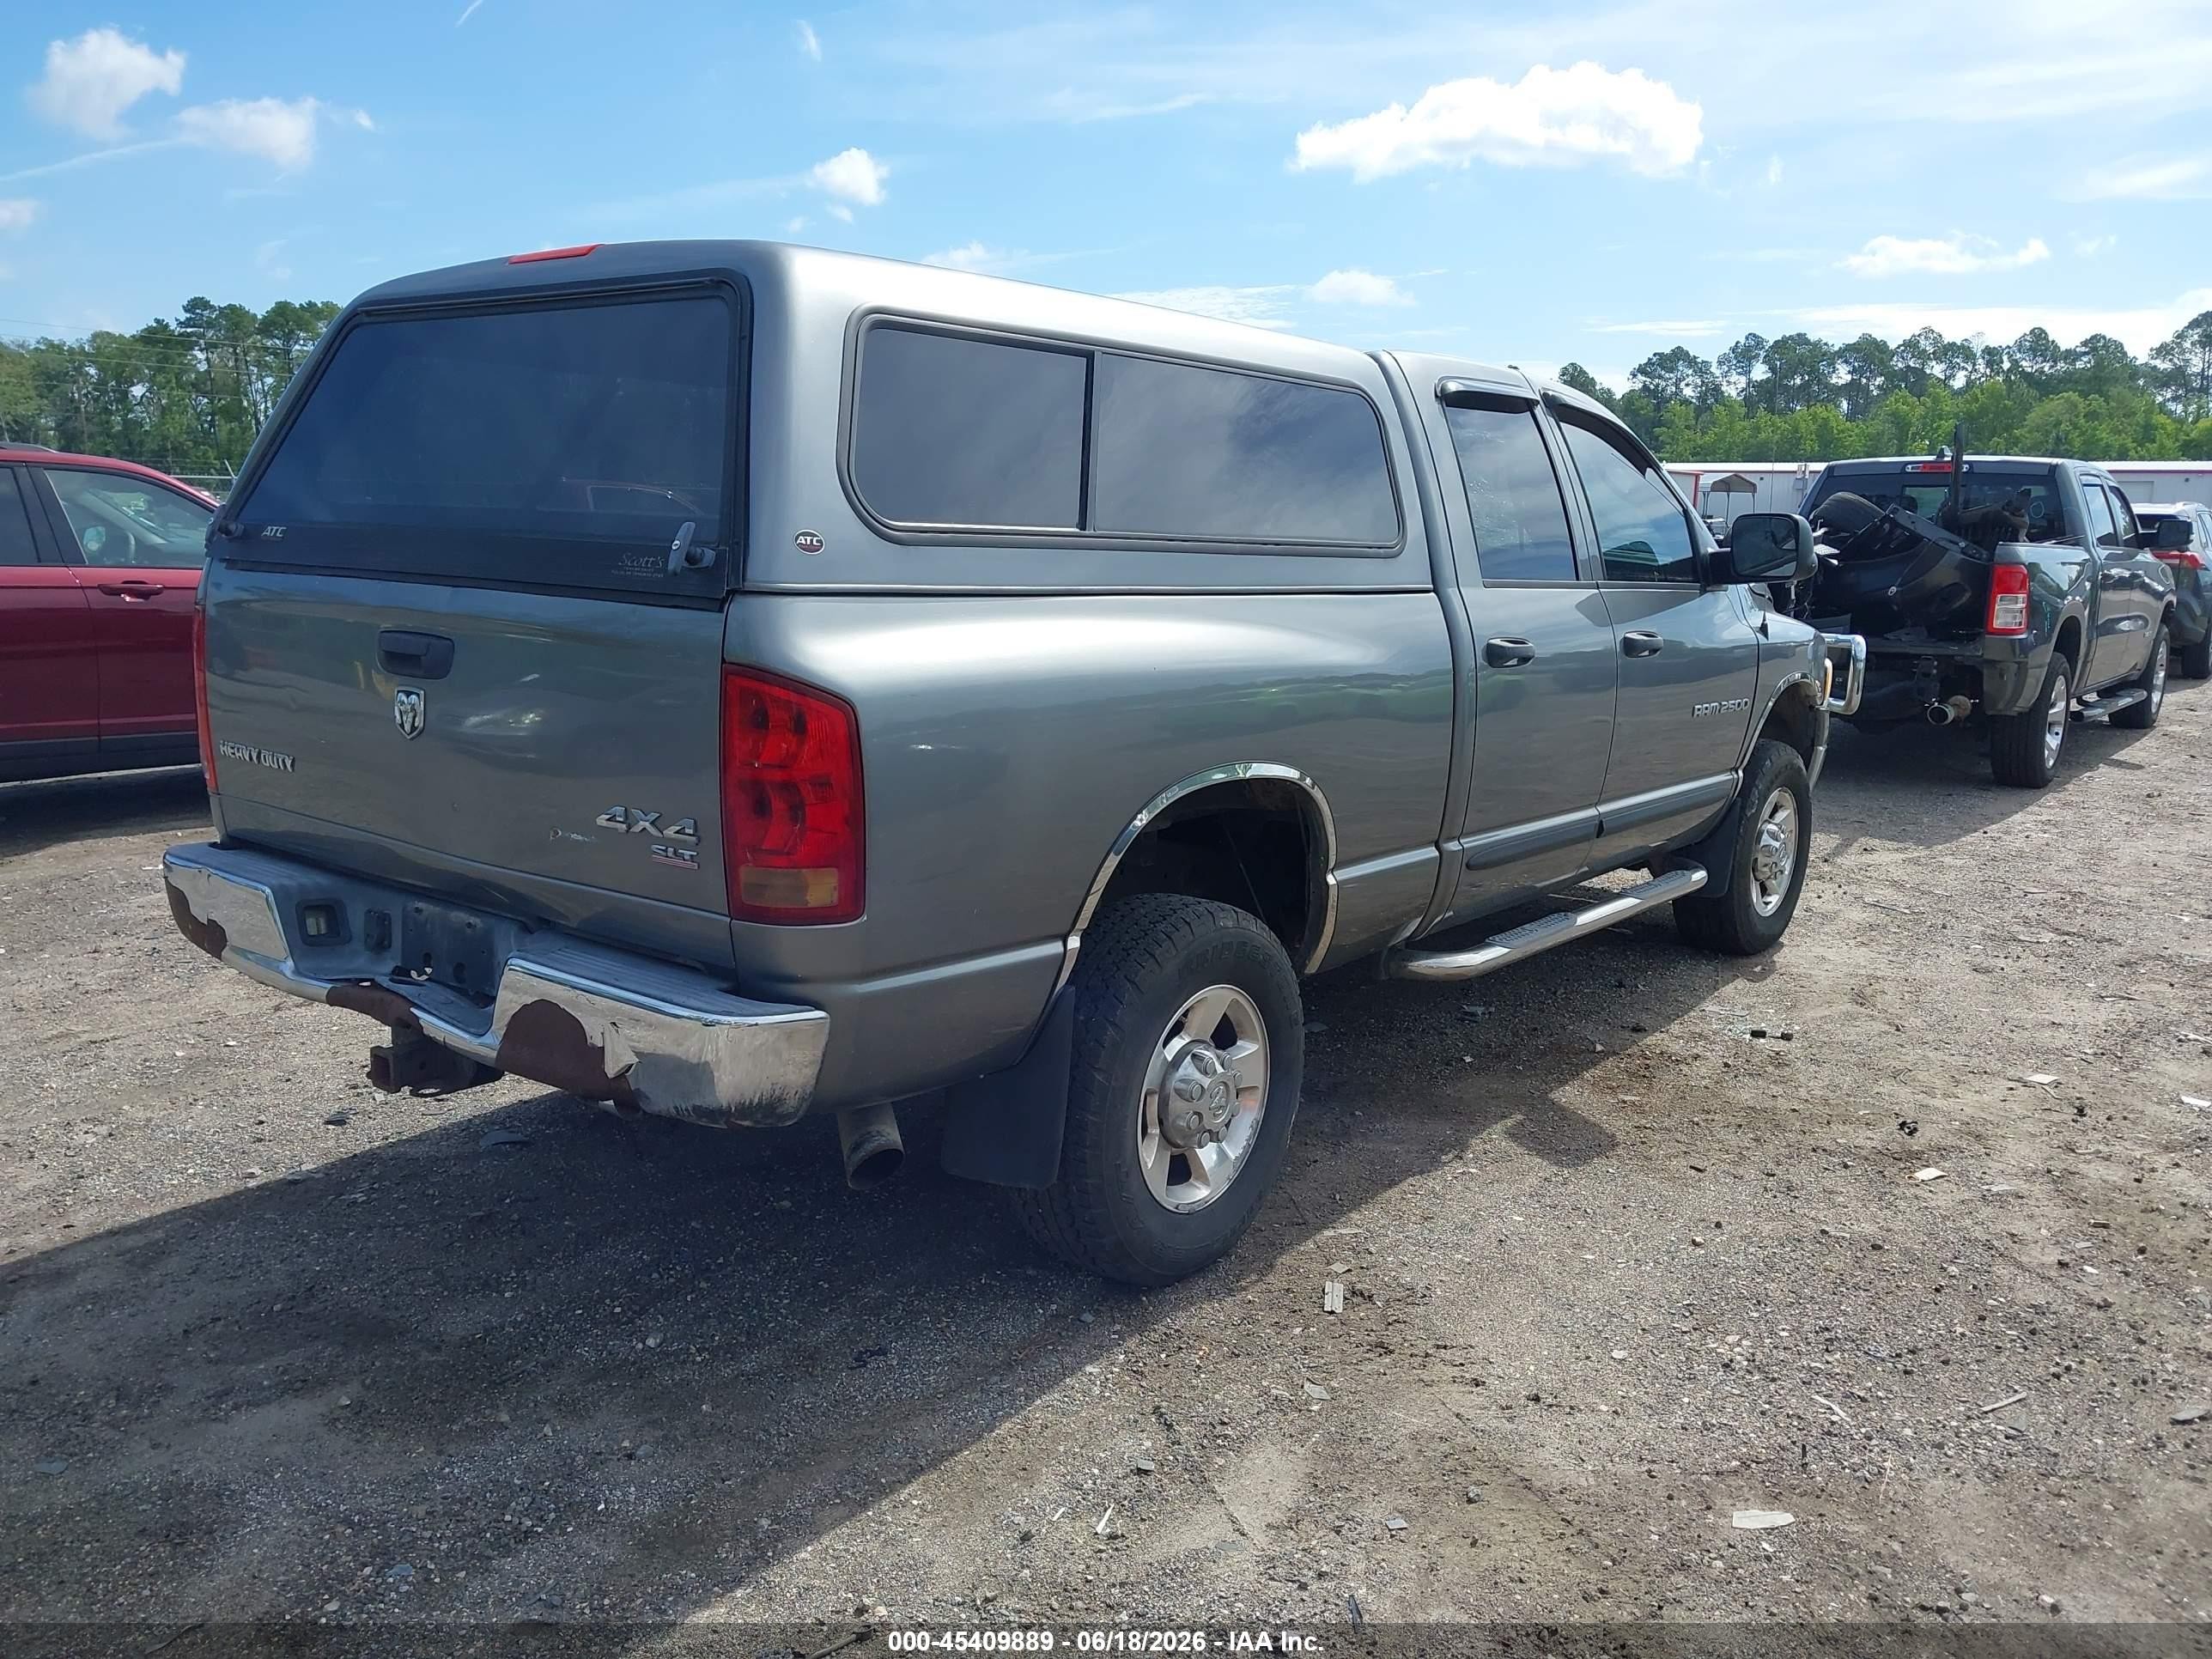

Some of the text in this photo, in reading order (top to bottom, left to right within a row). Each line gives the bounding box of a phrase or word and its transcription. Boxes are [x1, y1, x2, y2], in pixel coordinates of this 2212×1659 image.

[261, 526, 287, 537] ATC
[796, 535, 822, 546] ATC
[618, 552, 665, 568] Scott's
[1692, 697, 1750, 718] RAM 2500
[219, 740, 295, 772] HEAVY DUTY
[651, 844, 698, 861] SLT
